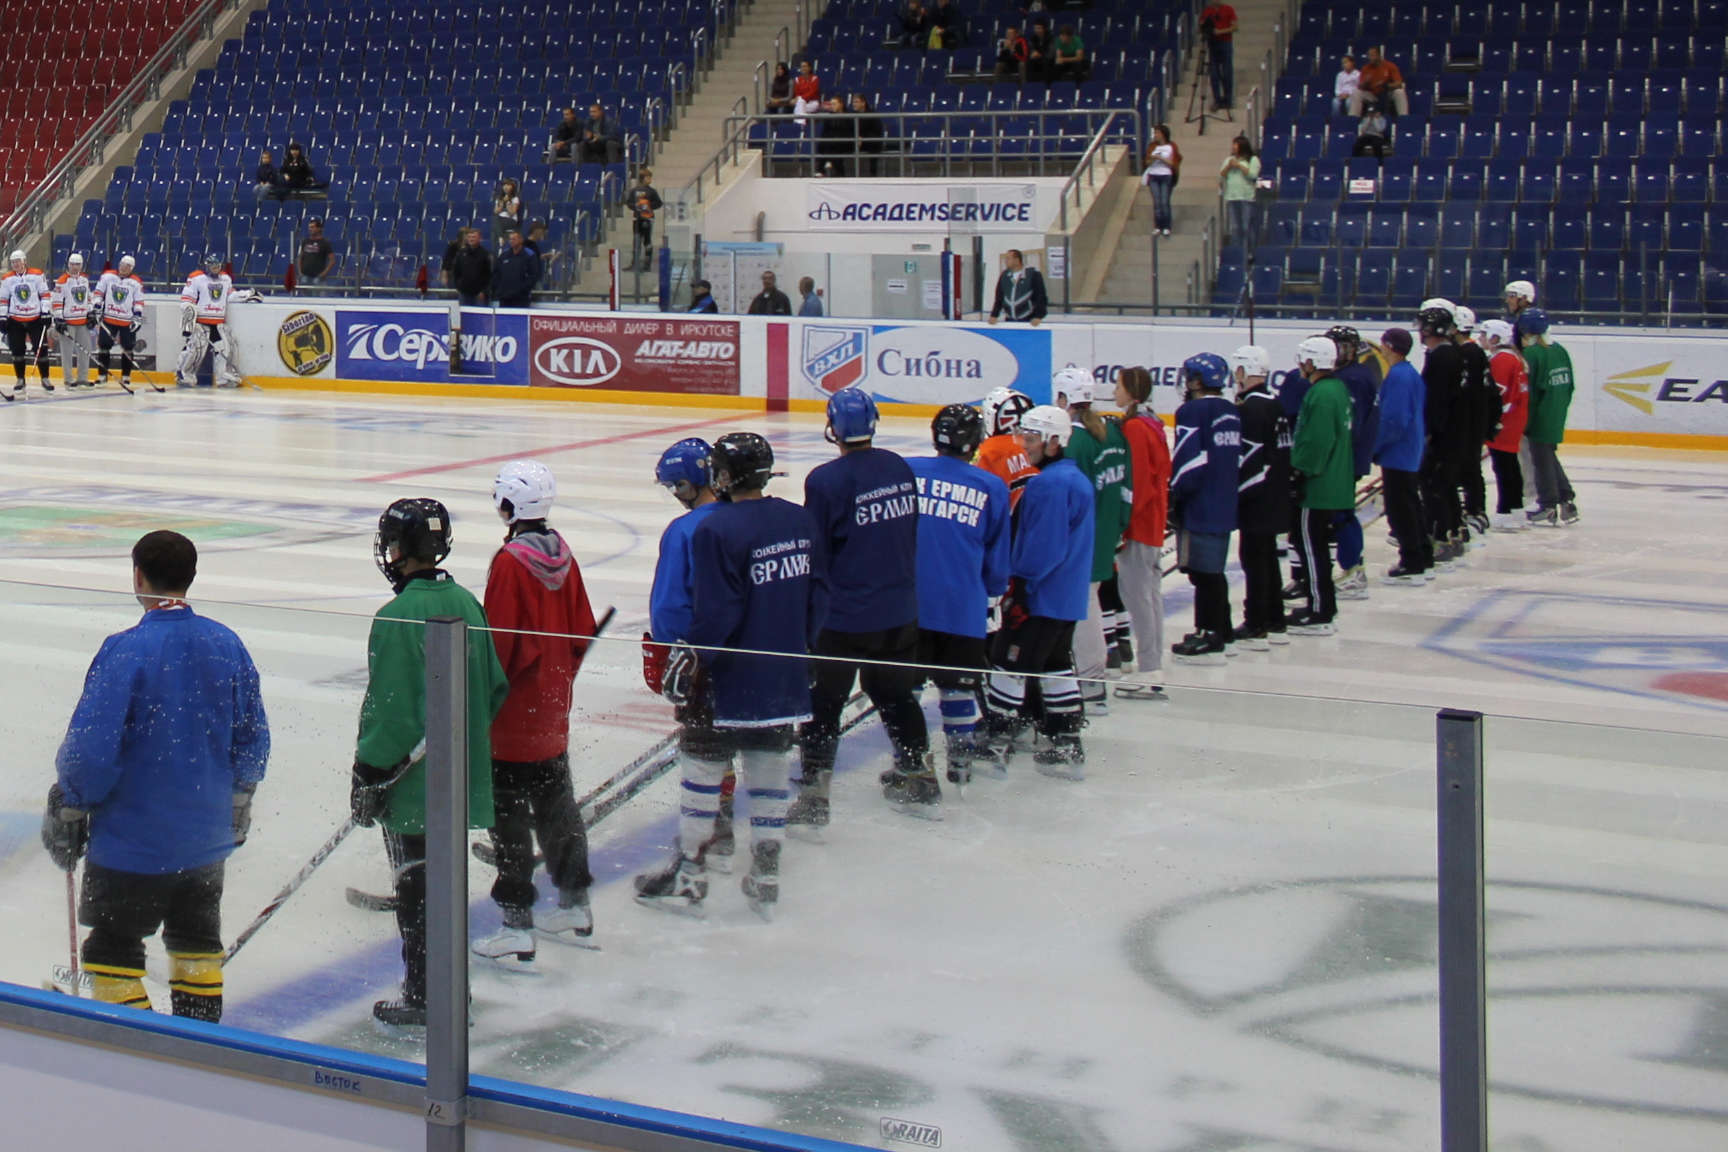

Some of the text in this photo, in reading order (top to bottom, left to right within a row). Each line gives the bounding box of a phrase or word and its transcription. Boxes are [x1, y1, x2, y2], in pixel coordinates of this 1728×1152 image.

[533, 319, 734, 337] ОФИЦИАЛЬНЫЙ ДИЛЕР В ИРКУТСКЕ
[550, 348, 608, 375] KIA
[634, 339, 735, 359] АГАТ-АВТО
[814, 341, 855, 376] ВХЛ
[877, 348, 982, 379] Сибна
[931, 478, 989, 512] ЕРМАК
[918, 495, 981, 528] НГАРСК
[314, 1070, 361, 1092] ВОСТОК
[426, 1102, 445, 1119] 12
